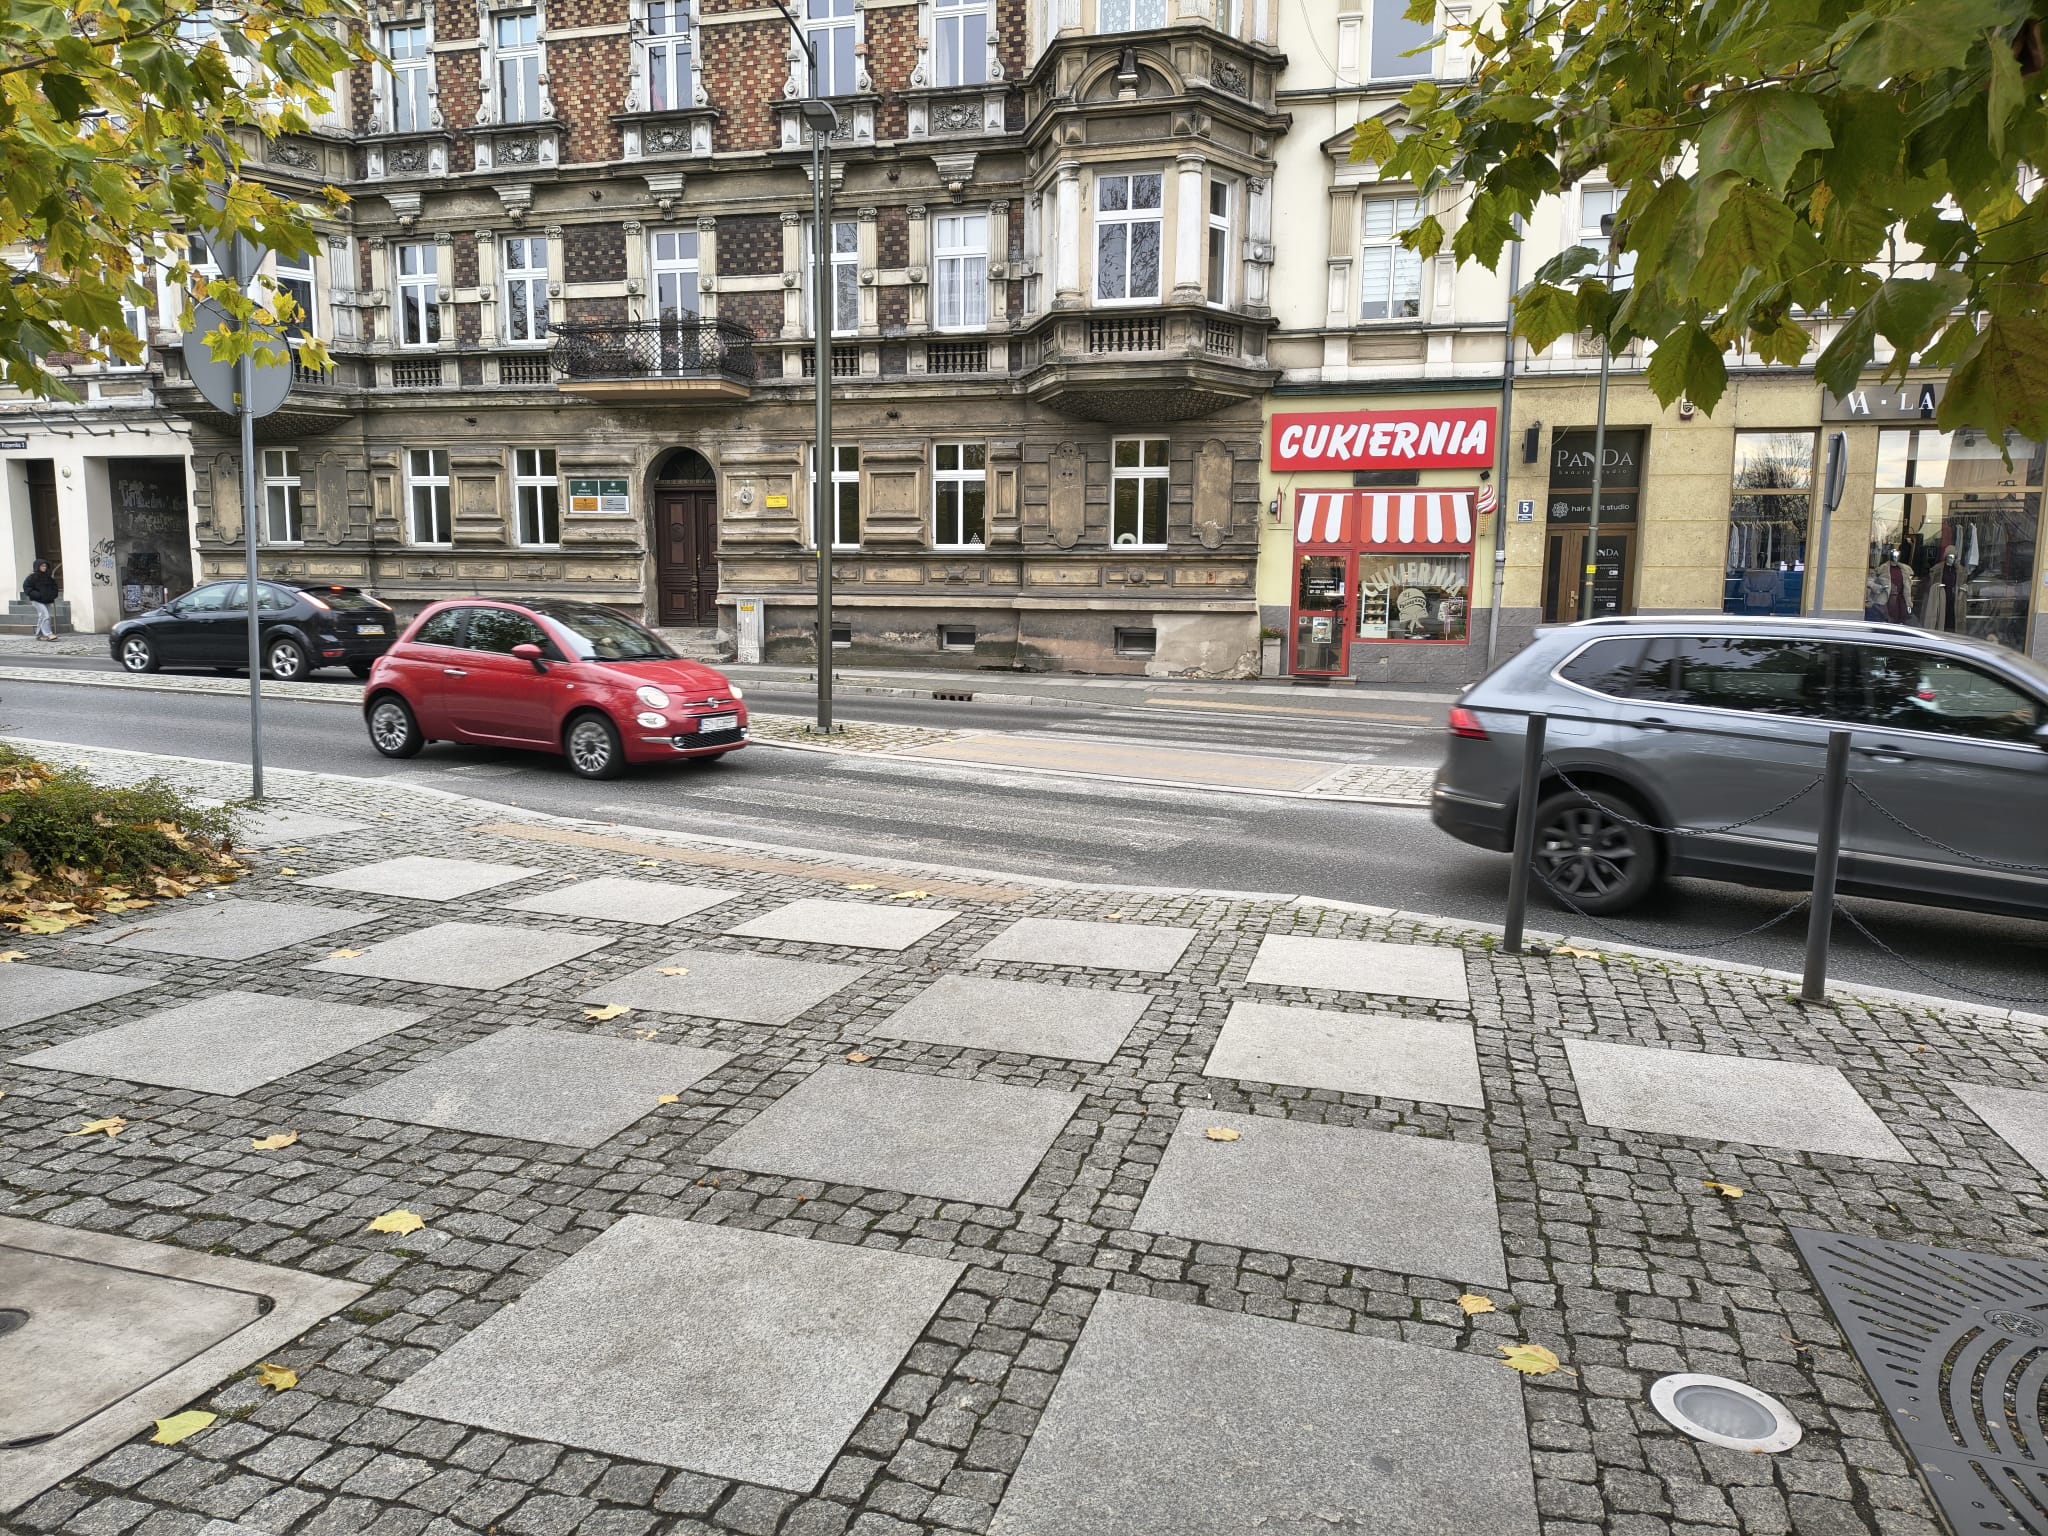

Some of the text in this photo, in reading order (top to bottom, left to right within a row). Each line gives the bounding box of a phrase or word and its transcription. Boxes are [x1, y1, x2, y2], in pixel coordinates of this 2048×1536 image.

[1279, 419, 1488, 461] CUKIERNIA
[1571, 504, 1586, 513] hair
[1606, 503, 1630, 511] studio
[1361, 562, 1466, 598] CUKIERNIA
